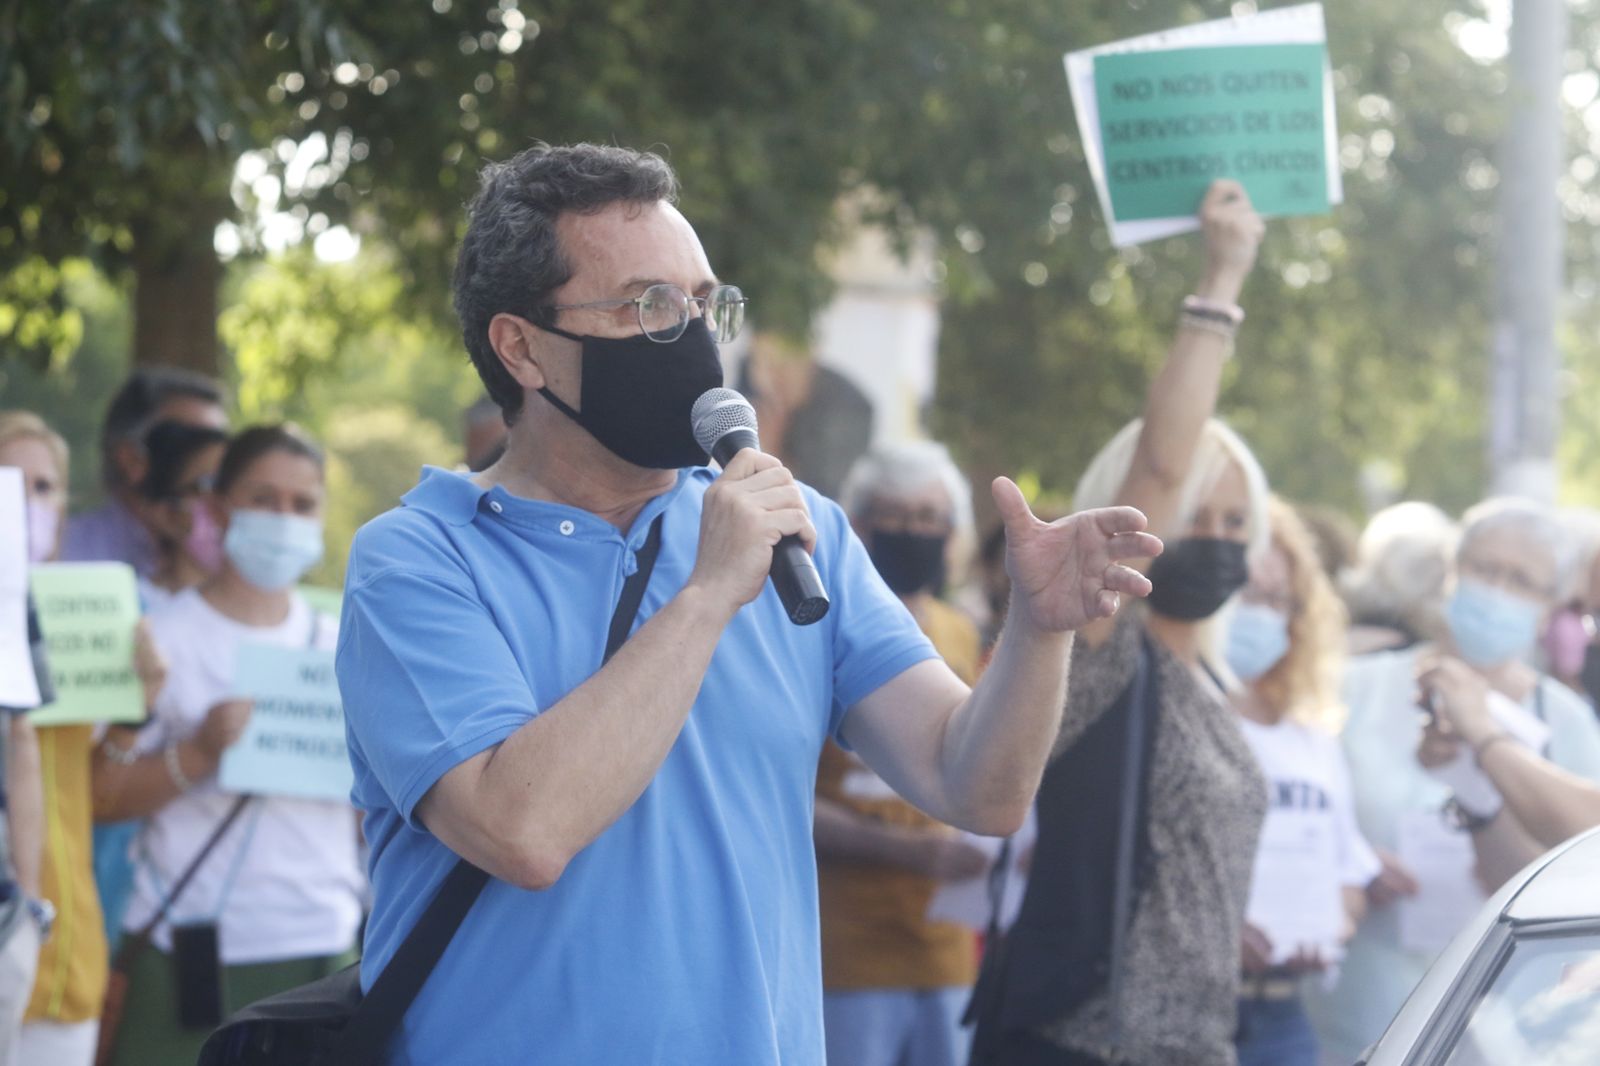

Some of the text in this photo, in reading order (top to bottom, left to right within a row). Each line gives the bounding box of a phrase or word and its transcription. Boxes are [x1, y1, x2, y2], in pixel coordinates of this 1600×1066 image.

[1112, 70, 1310, 103] NO NOS QUITEN
[1109, 109, 1319, 144] SERVICIOS DE LOS
[1112, 148, 1320, 184] CENTROS CÍVICOS
